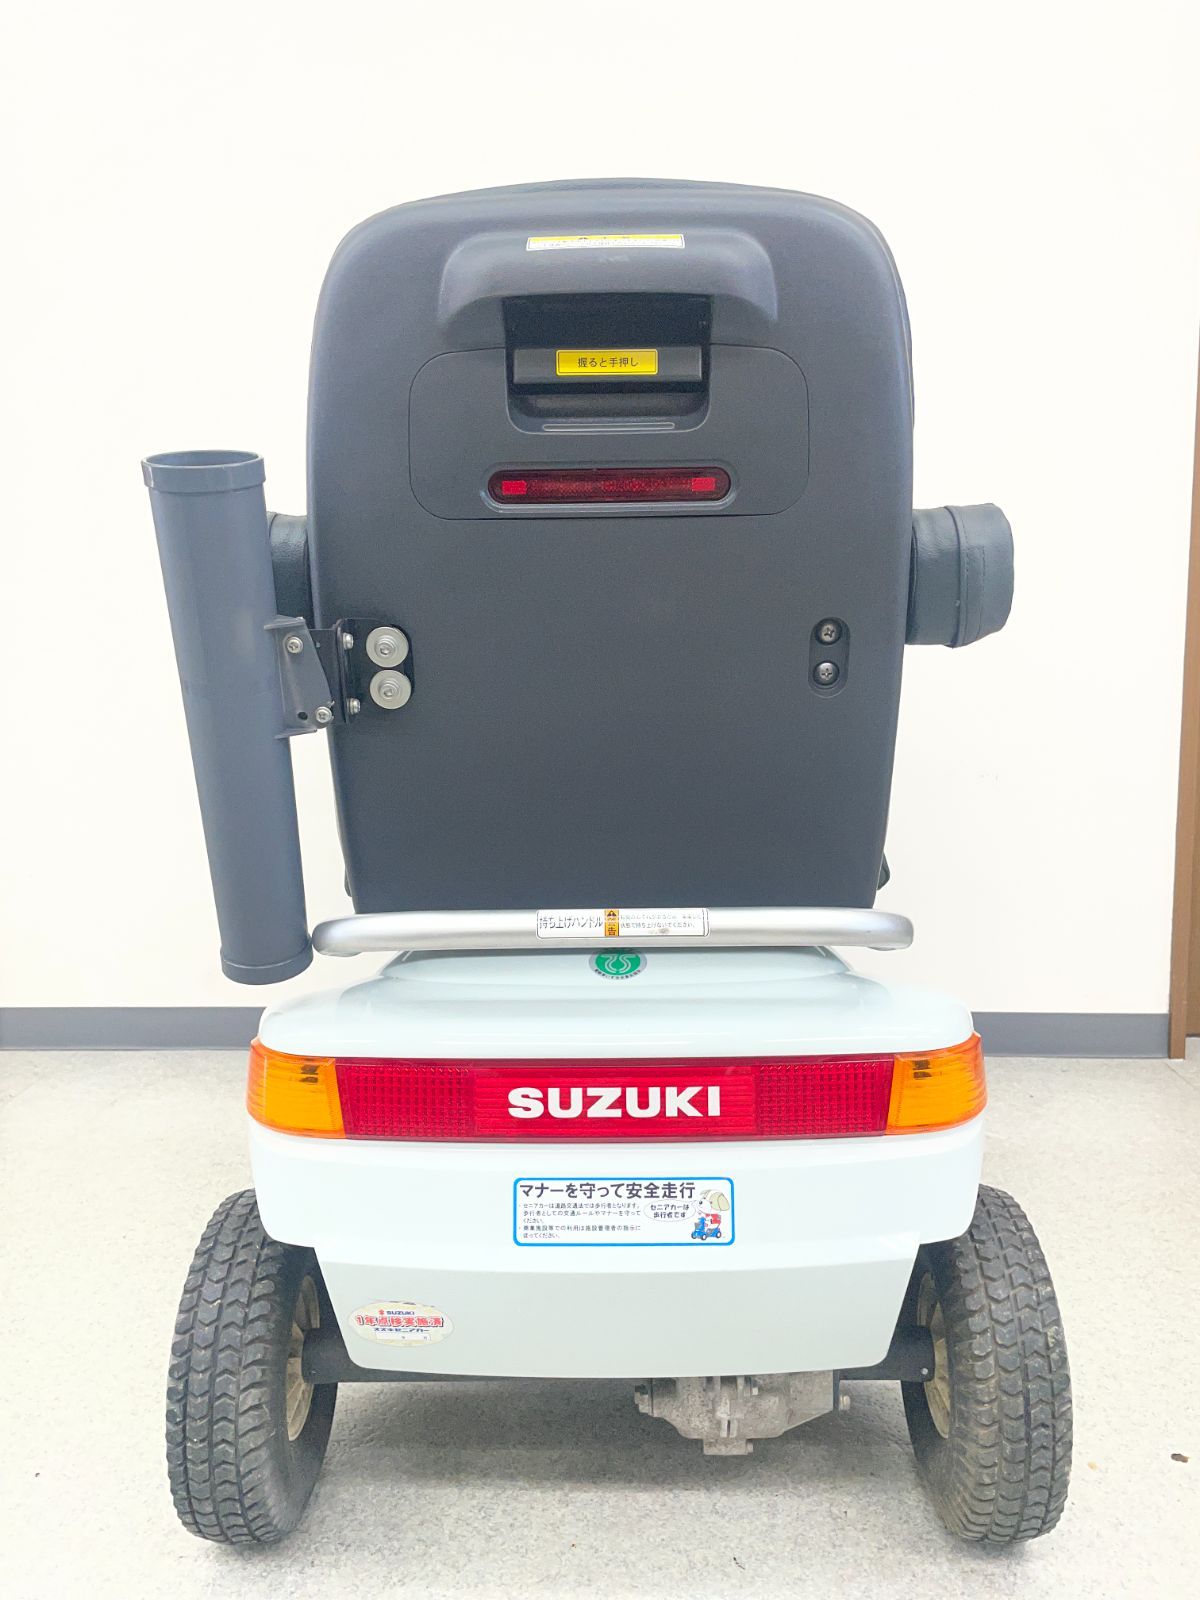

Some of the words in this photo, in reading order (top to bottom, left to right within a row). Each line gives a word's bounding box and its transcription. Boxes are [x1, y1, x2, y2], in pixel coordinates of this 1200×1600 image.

[577, 357, 639, 368] 握ると手押し
[507, 1086, 721, 1119] SUZUKI
[519, 1181, 696, 1200] マナーを守って安全走行
[650, 1203, 690, 1211] セニアカーは
